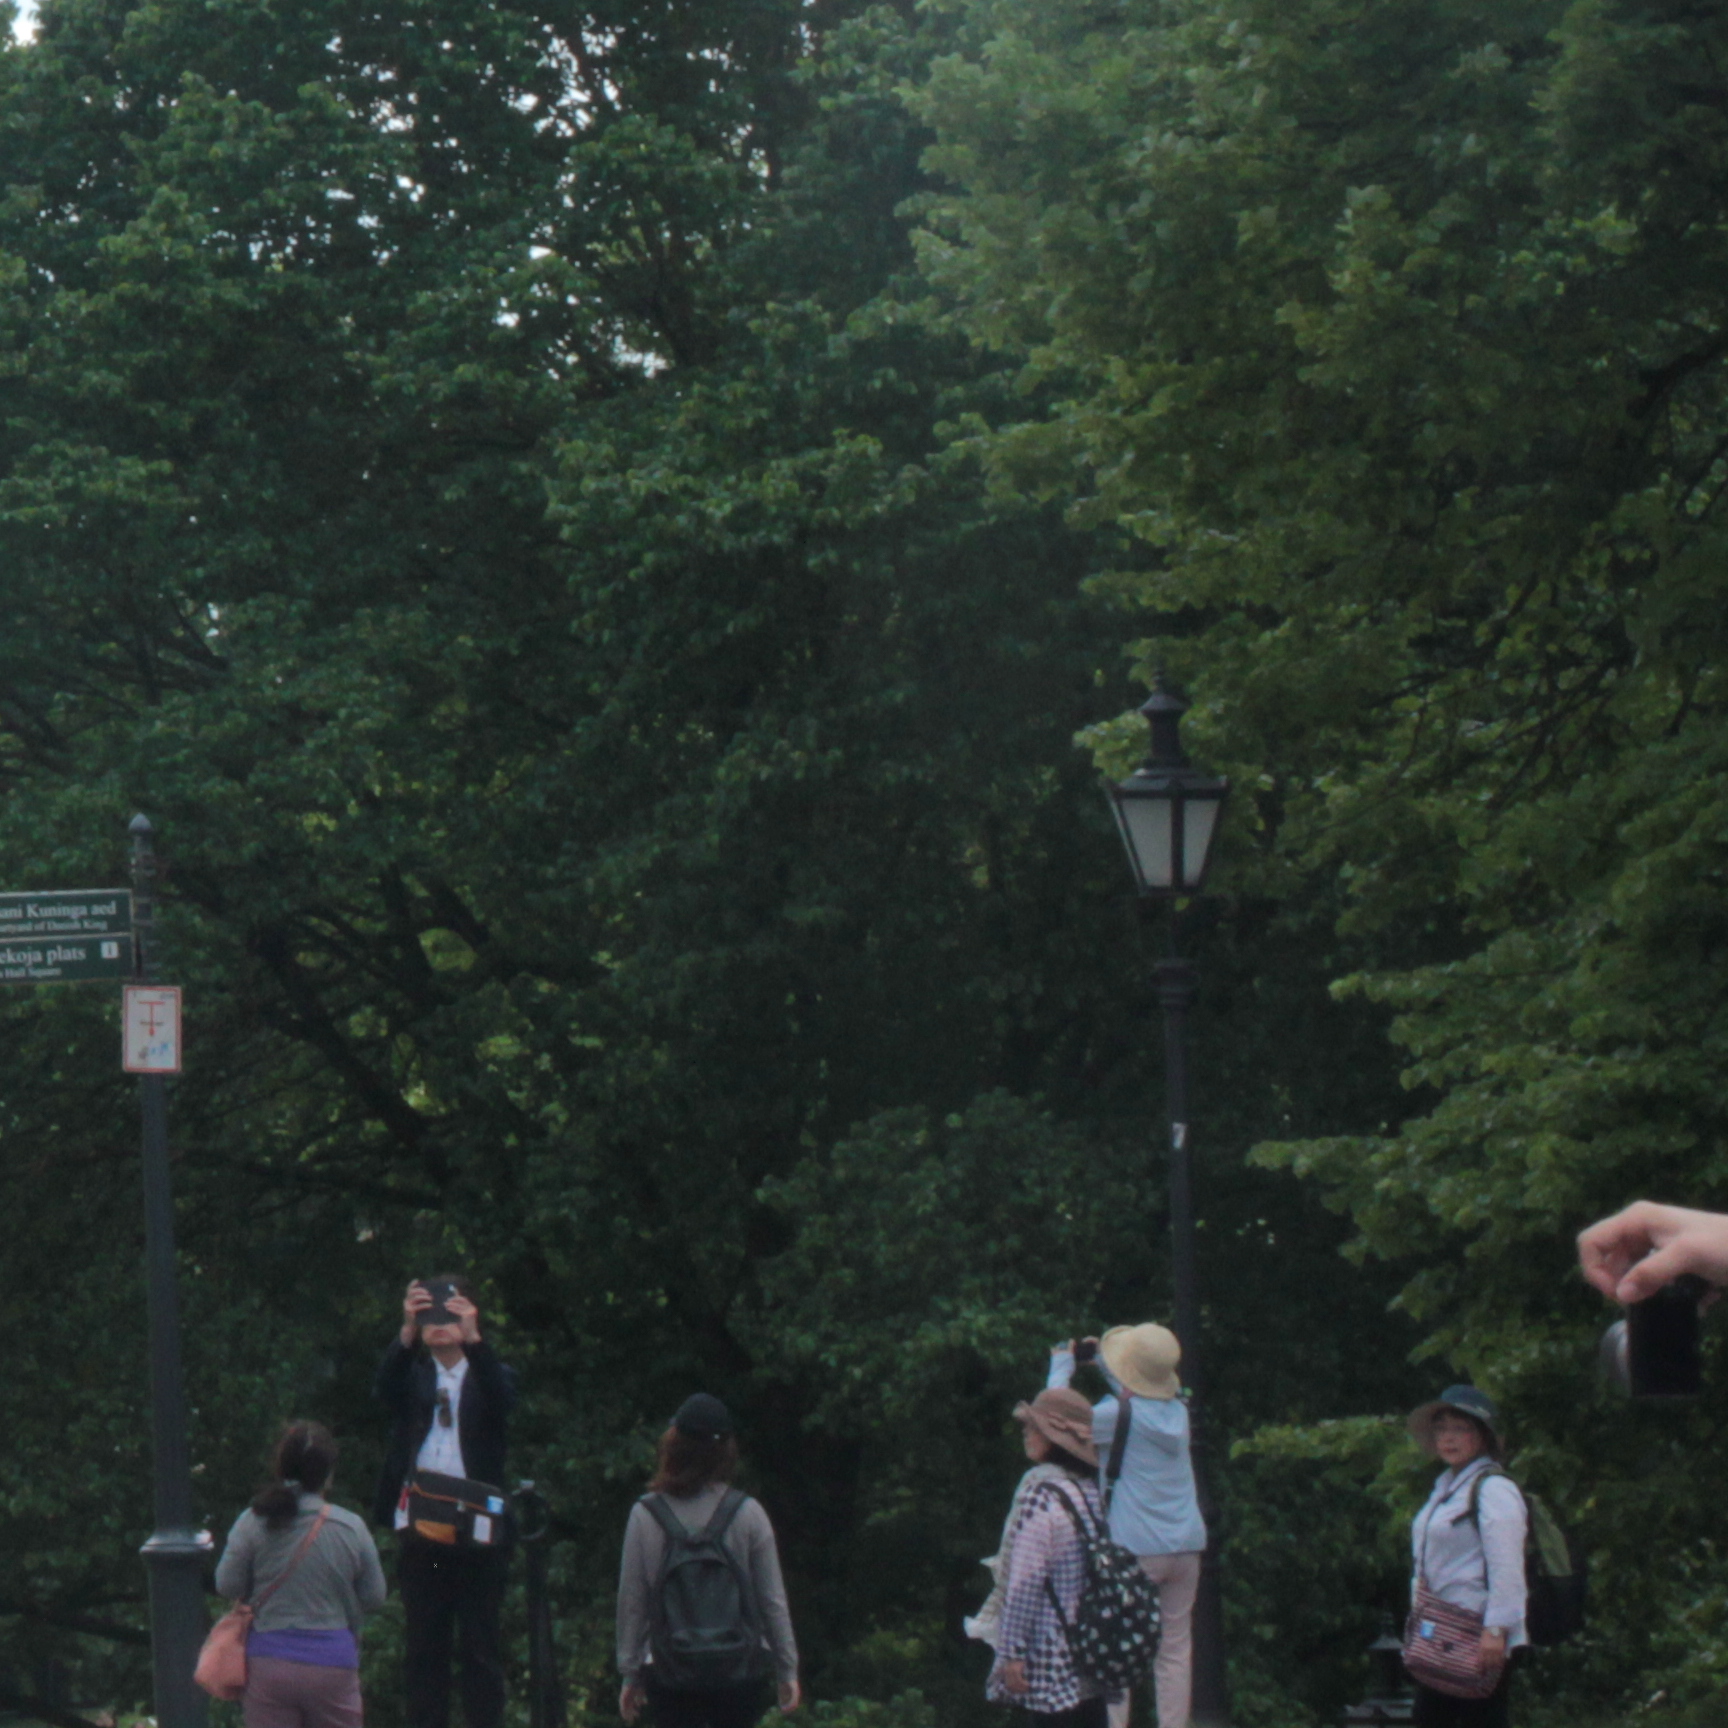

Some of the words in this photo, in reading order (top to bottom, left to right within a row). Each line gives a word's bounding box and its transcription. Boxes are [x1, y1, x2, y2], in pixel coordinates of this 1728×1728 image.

[26, 902, 88, 919] Kuninga
[91, 900, 117, 915] aed
[46, 944, 87, 966] plats
